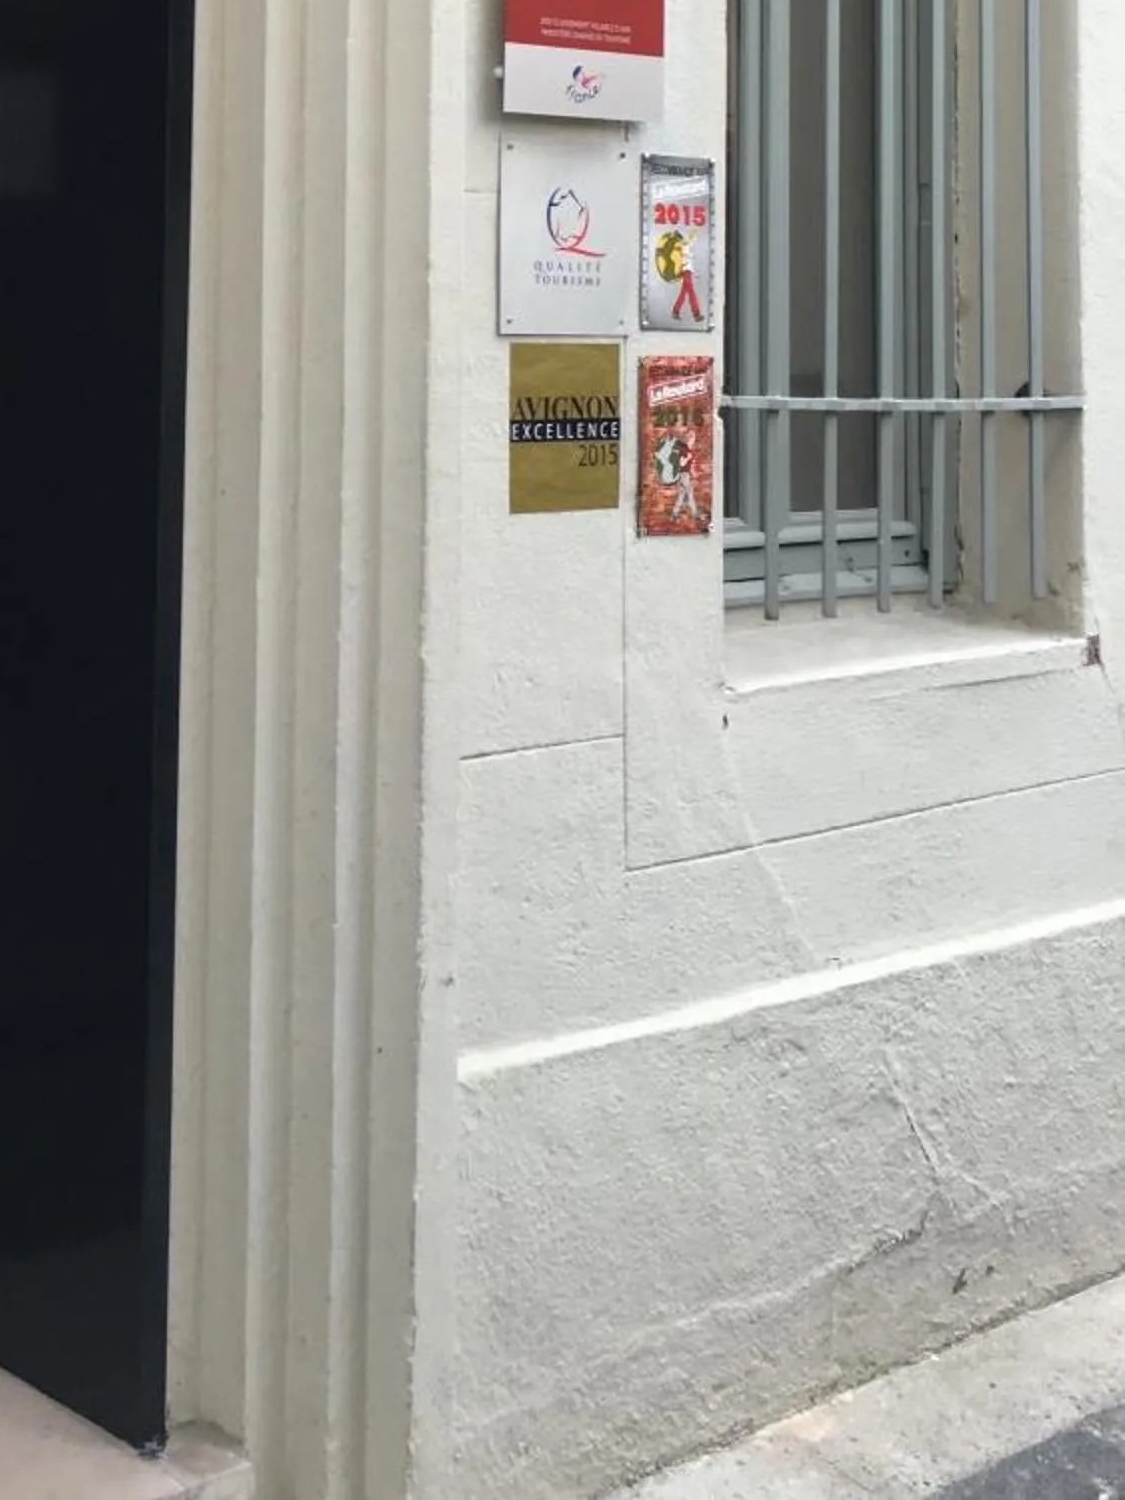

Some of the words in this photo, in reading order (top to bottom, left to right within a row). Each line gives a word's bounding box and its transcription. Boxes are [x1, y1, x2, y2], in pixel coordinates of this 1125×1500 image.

[653, 202, 706, 226] 2015
[533, 274, 601, 287] TOURISME
[511, 396, 619, 421] AVIGNON
[511, 422, 619, 441] EXCELLENCE
[578, 444, 619, 467] 2015
